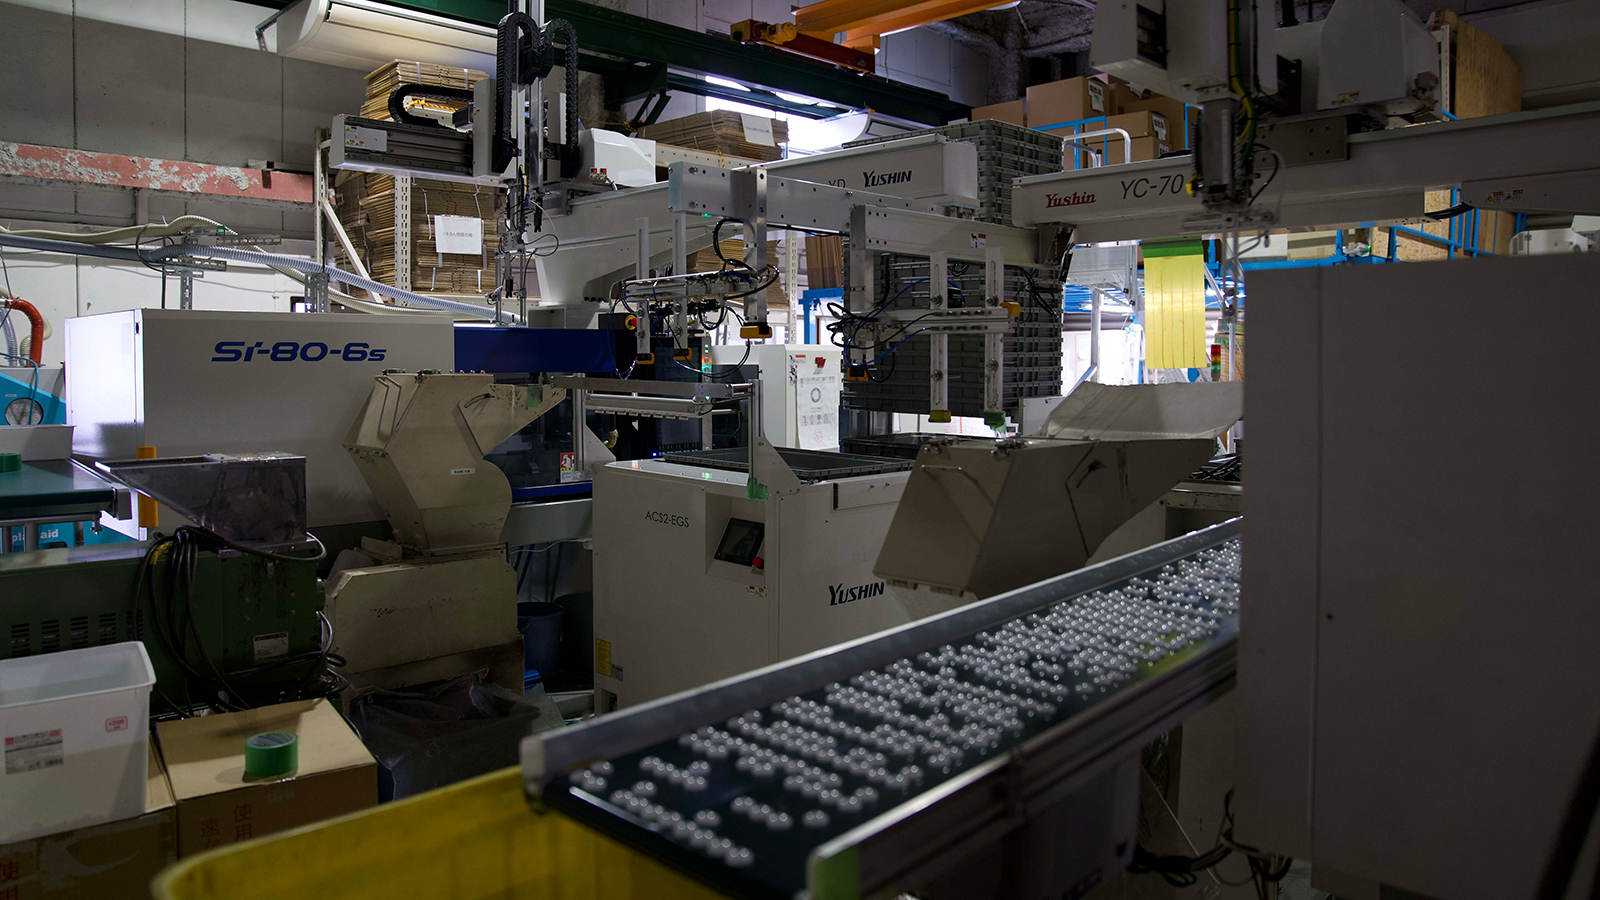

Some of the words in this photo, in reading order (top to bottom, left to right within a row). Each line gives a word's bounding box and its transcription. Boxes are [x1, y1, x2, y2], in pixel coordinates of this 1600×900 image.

[862, 170, 912, 188] YUSHIN
[1121, 173, 1185, 199] YC-70
[1045, 191, 1097, 208] Yushin
[644, 510, 690, 528] ACS2-EGS
[828, 581, 885, 606] YUSHIN
